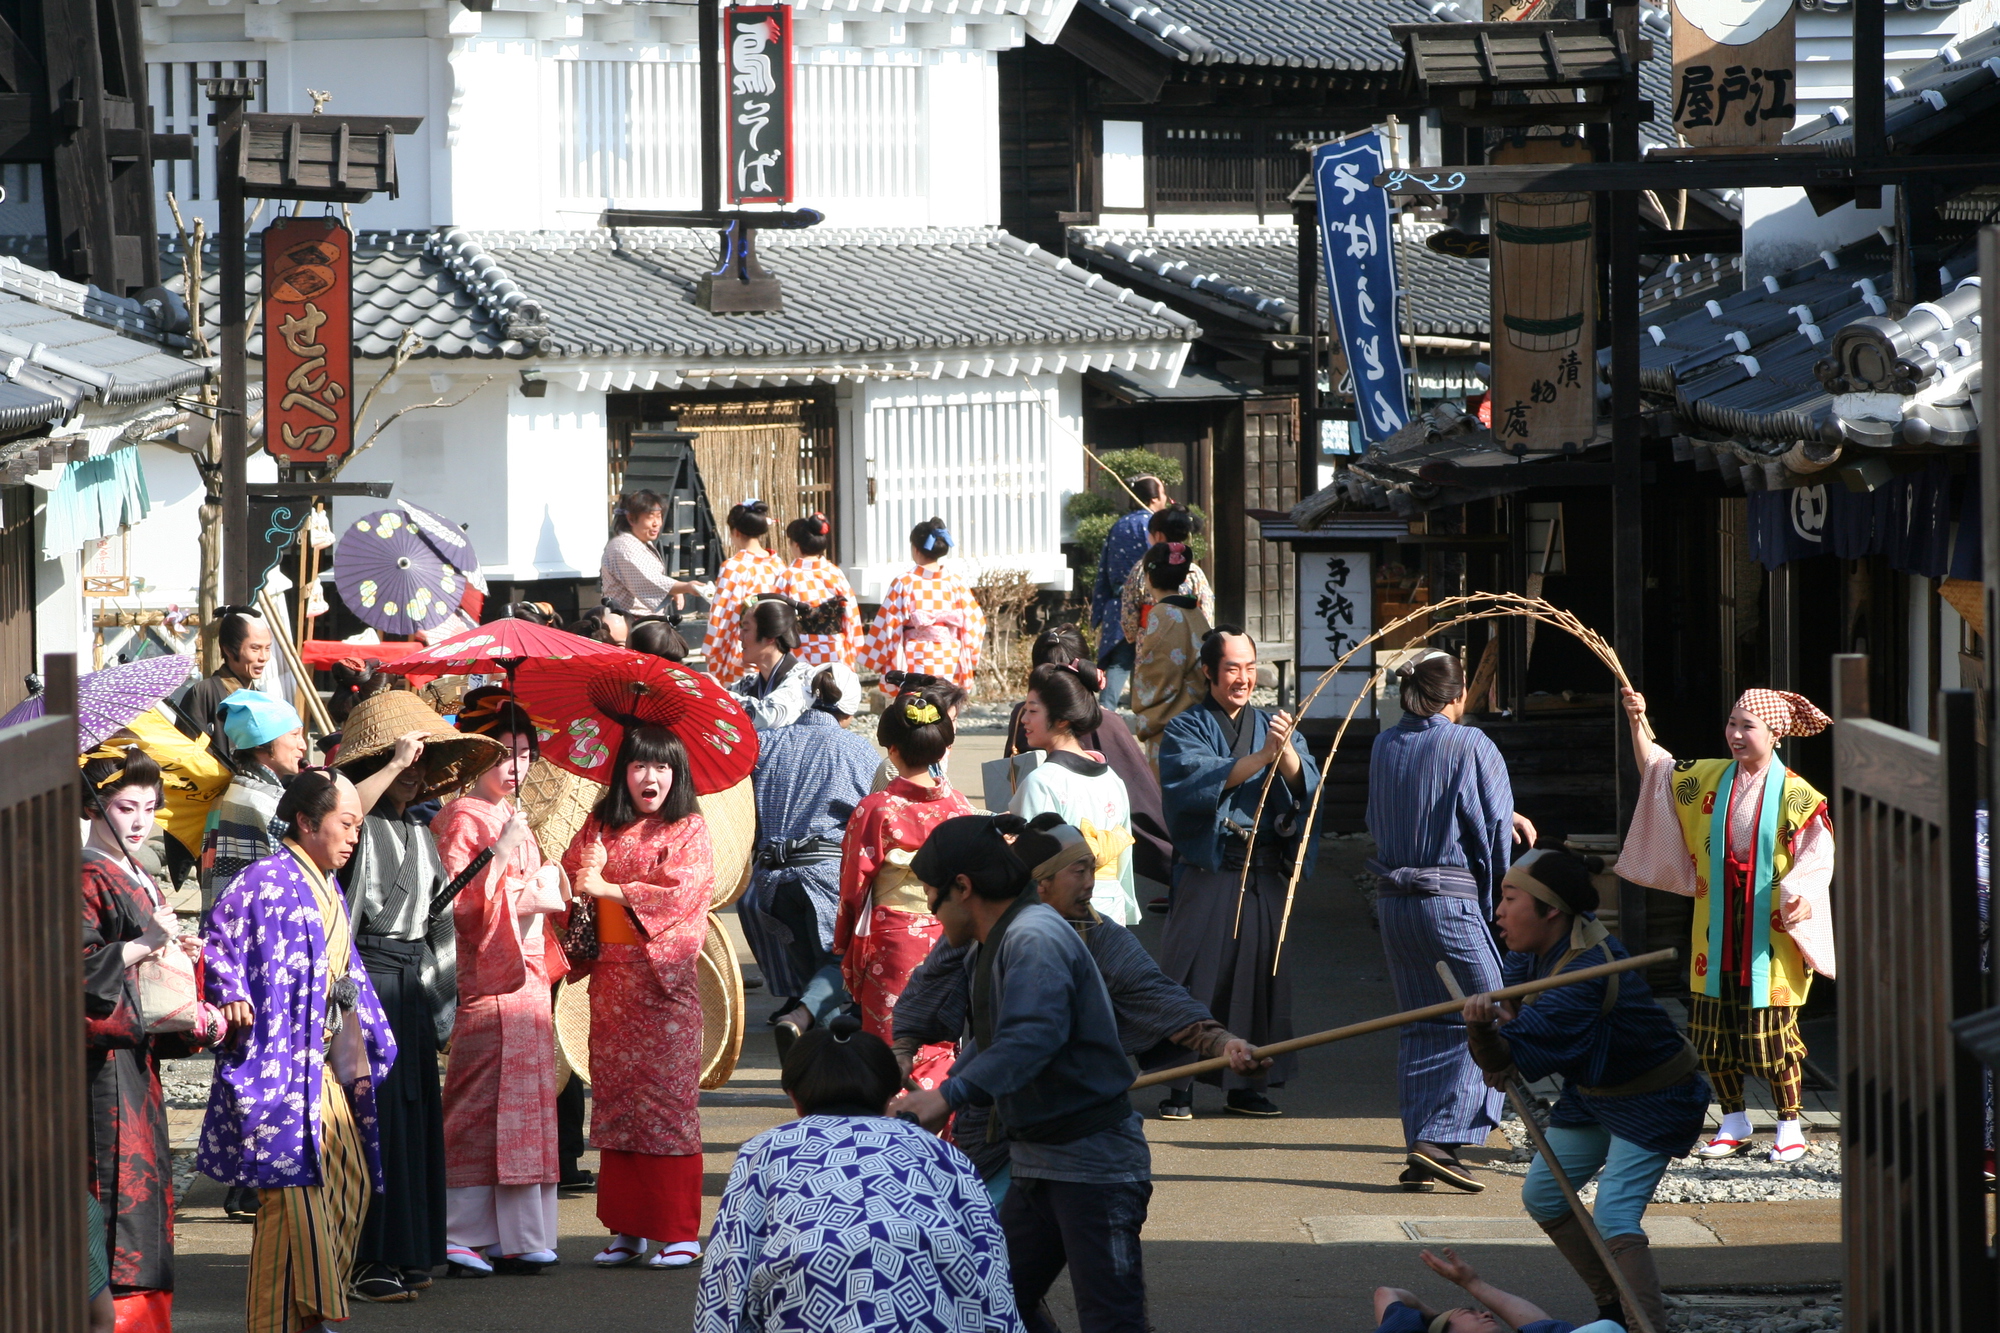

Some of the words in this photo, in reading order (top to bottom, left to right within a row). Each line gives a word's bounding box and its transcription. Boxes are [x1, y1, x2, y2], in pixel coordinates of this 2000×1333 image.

[1673, 65, 1796, 129] 江戸屋
[277, 302, 345, 453] せんべい
